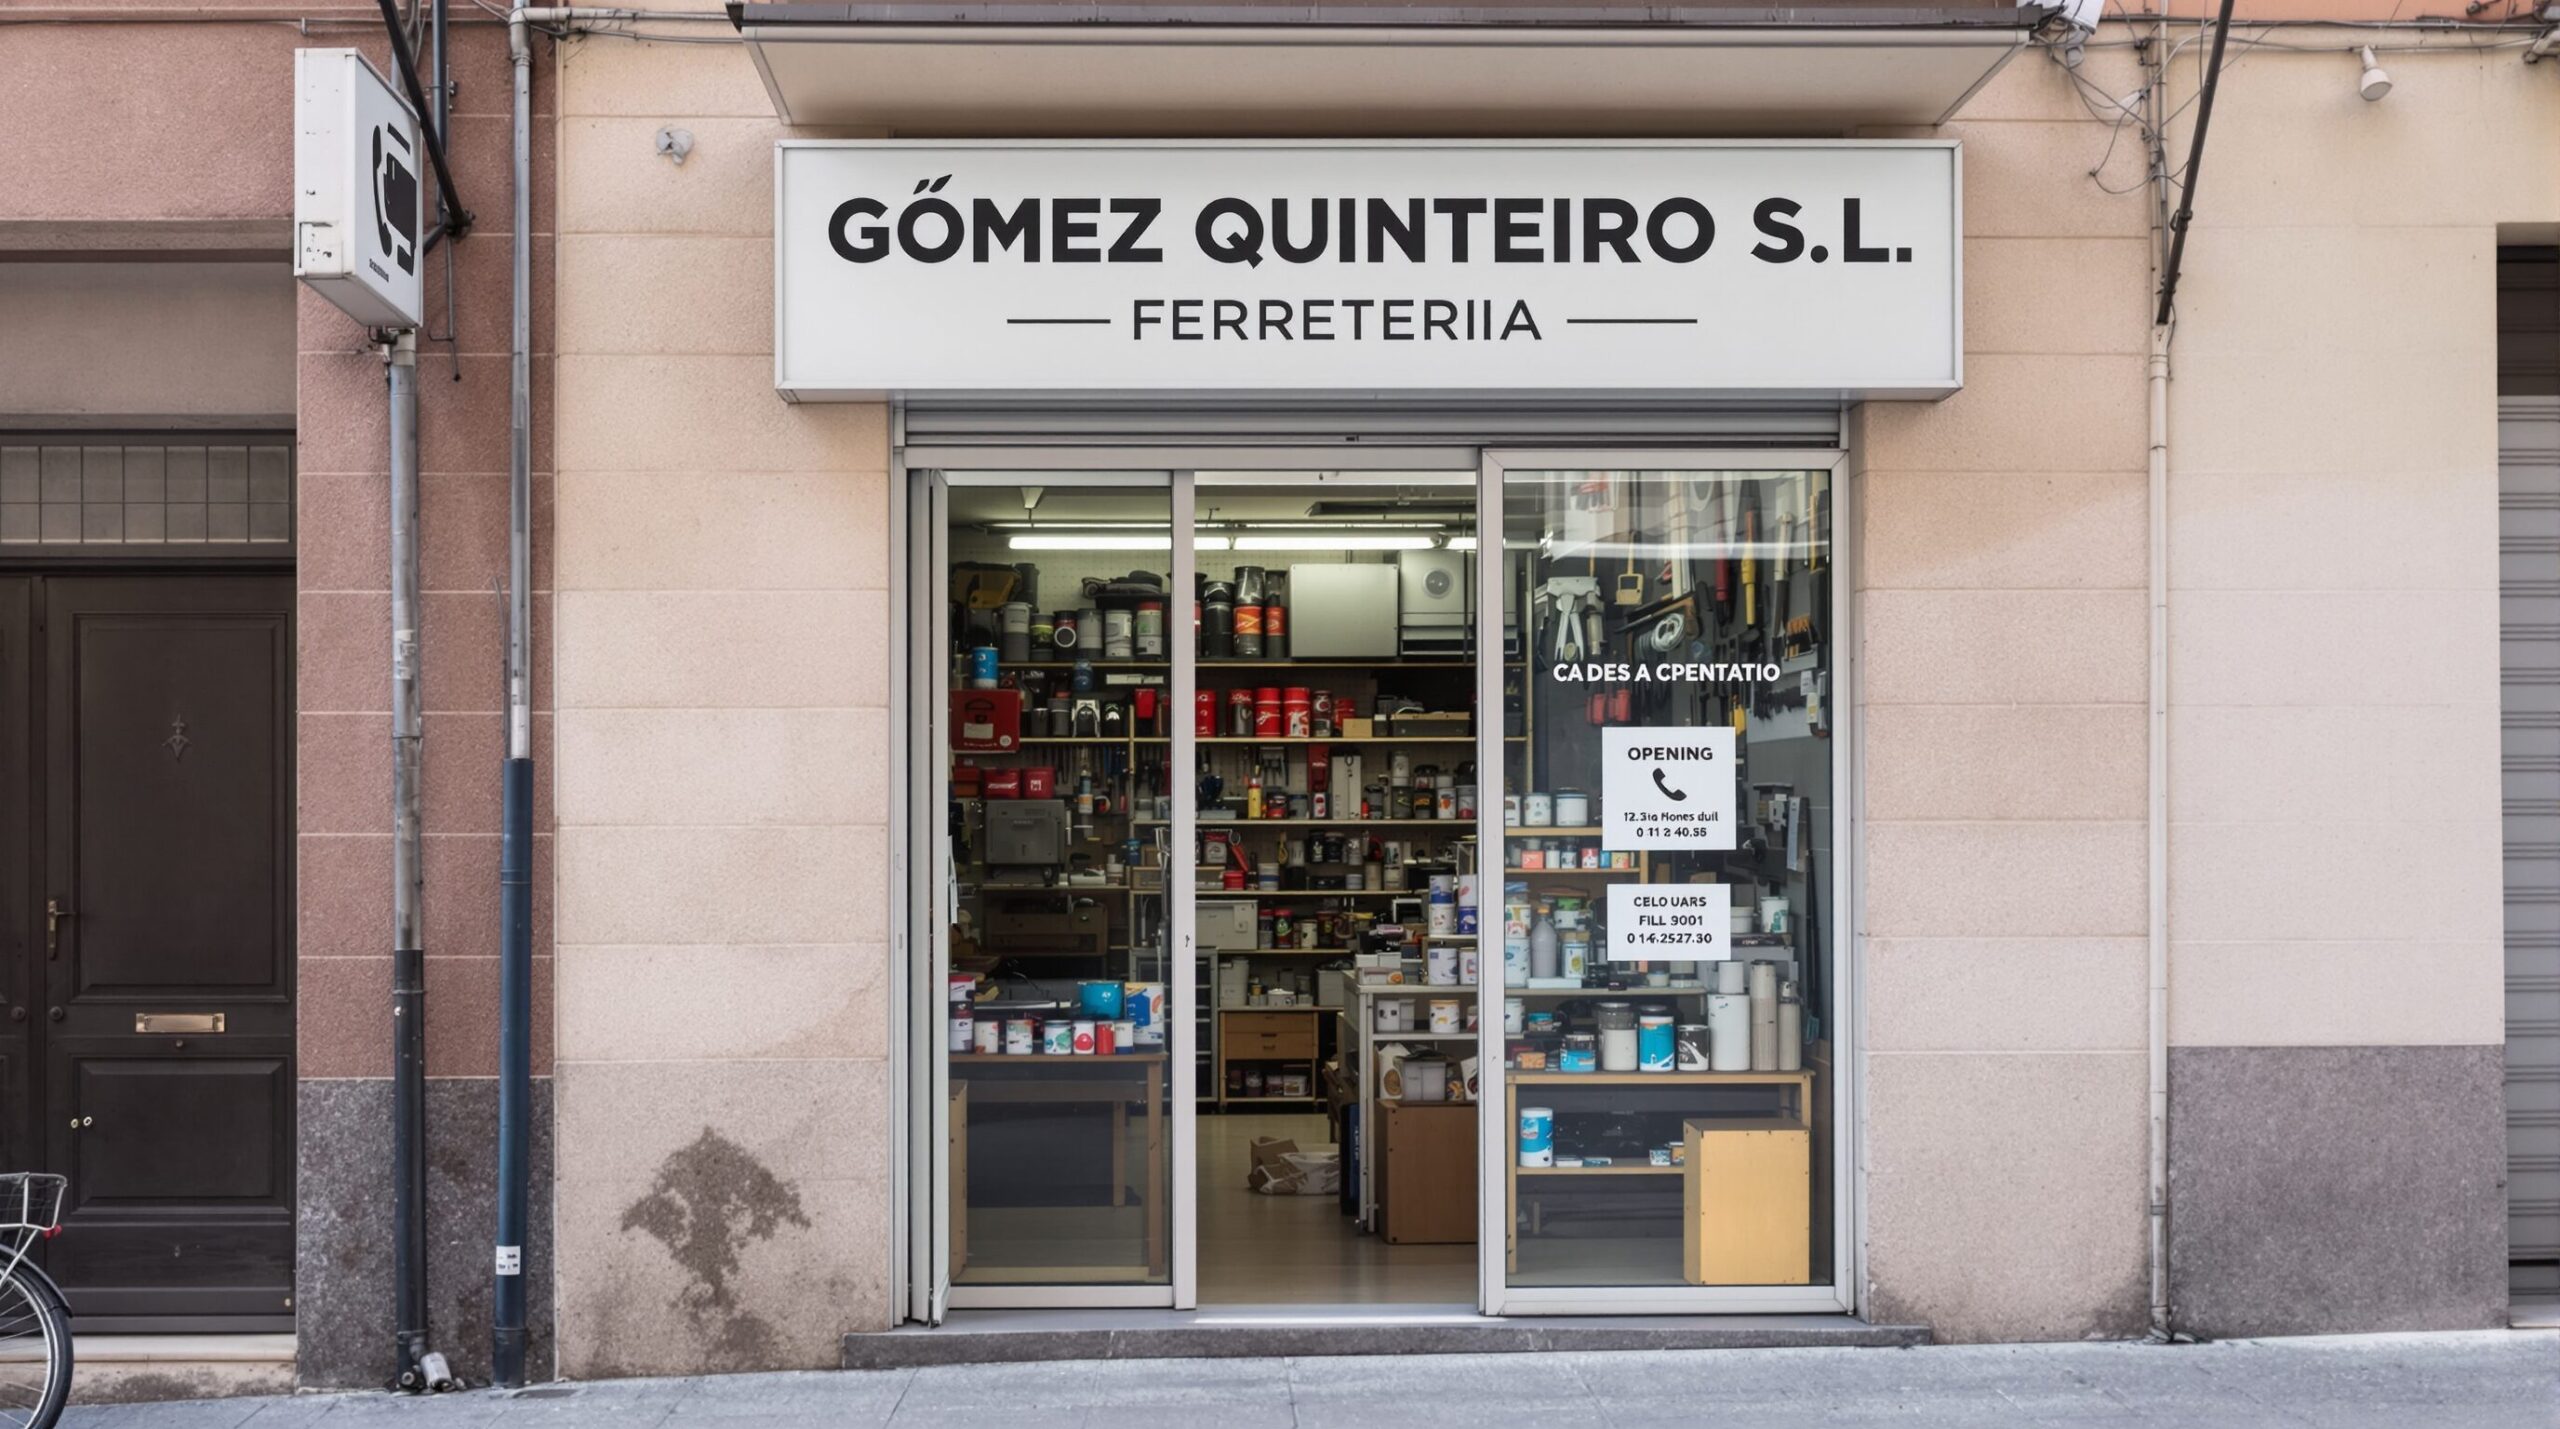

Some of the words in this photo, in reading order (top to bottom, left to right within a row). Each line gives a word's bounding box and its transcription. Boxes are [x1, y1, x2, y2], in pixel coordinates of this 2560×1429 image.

[1194, 197, 1716, 270] QUINTEIRO
[1750, 197, 1912, 264] S.L.
[1133, 299, 1542, 341] FERRETERIIA
[1587, 663, 1631, 682] DES
[1656, 663, 1780, 682] CPENTATIO
[1627, 746, 1713, 761] OPENING
[1633, 896, 1668, 908] CELO
[1670, 896, 1707, 908] UARS
[1639, 914, 1667, 926] FILL
[1670, 914, 1703, 926] 9001
